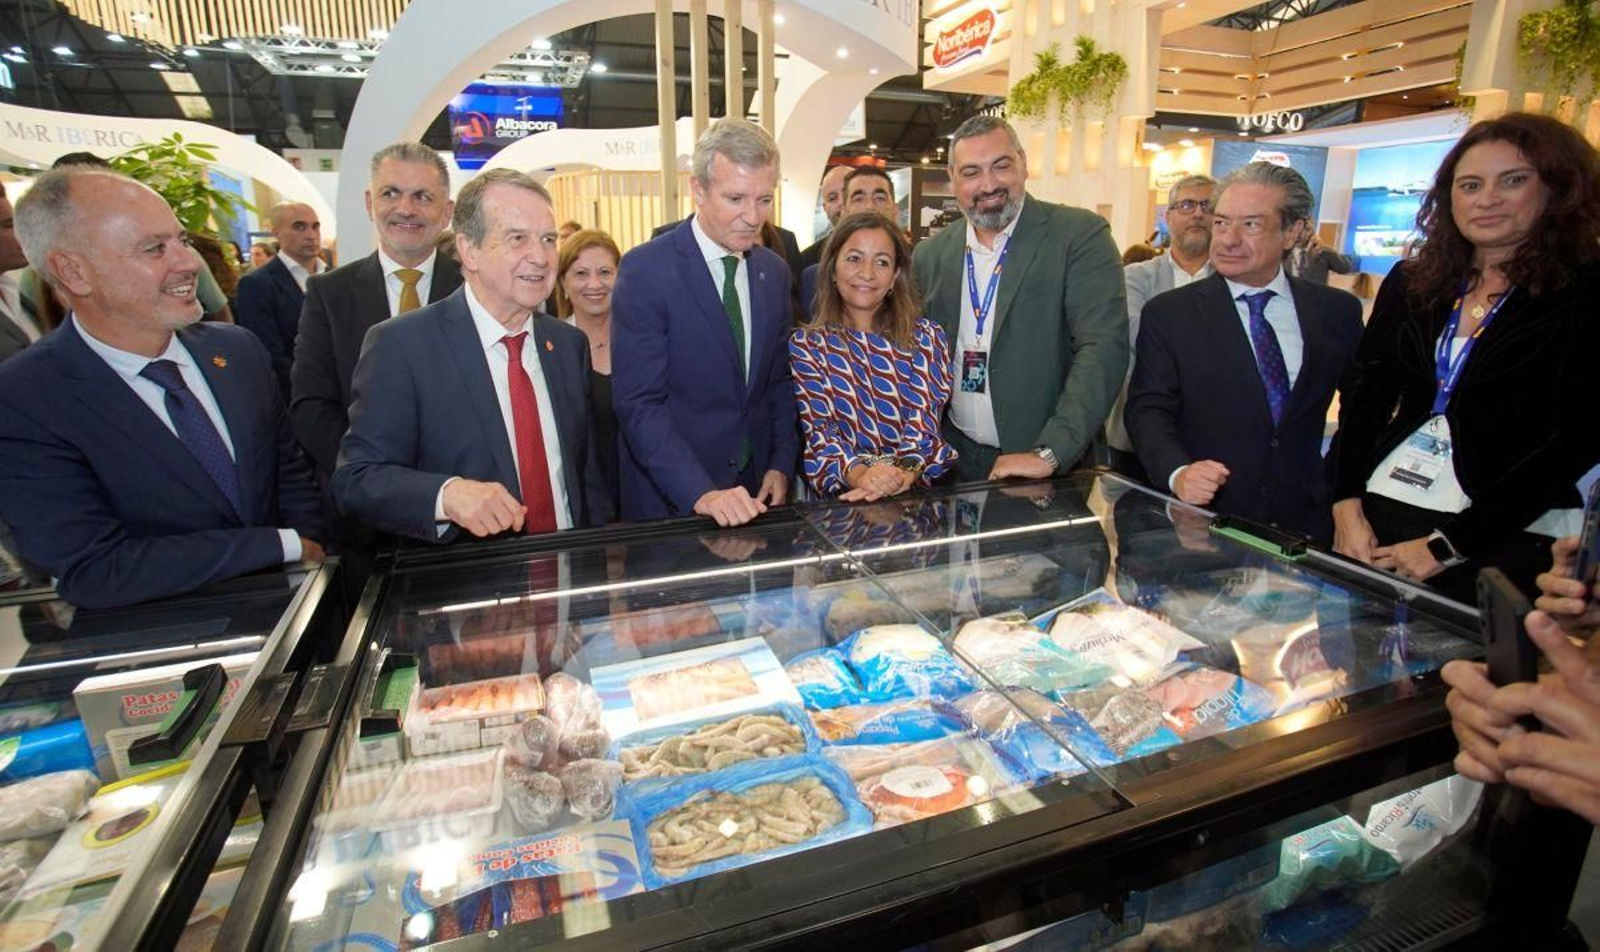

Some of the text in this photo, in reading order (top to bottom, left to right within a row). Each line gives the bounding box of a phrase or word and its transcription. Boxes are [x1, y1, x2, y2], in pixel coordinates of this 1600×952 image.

[495, 118, 558, 131] Albacora
[495, 130, 529, 138] GROUP
[124, 690, 179, 707] Patas
[126, 703, 172, 717] Cocid
